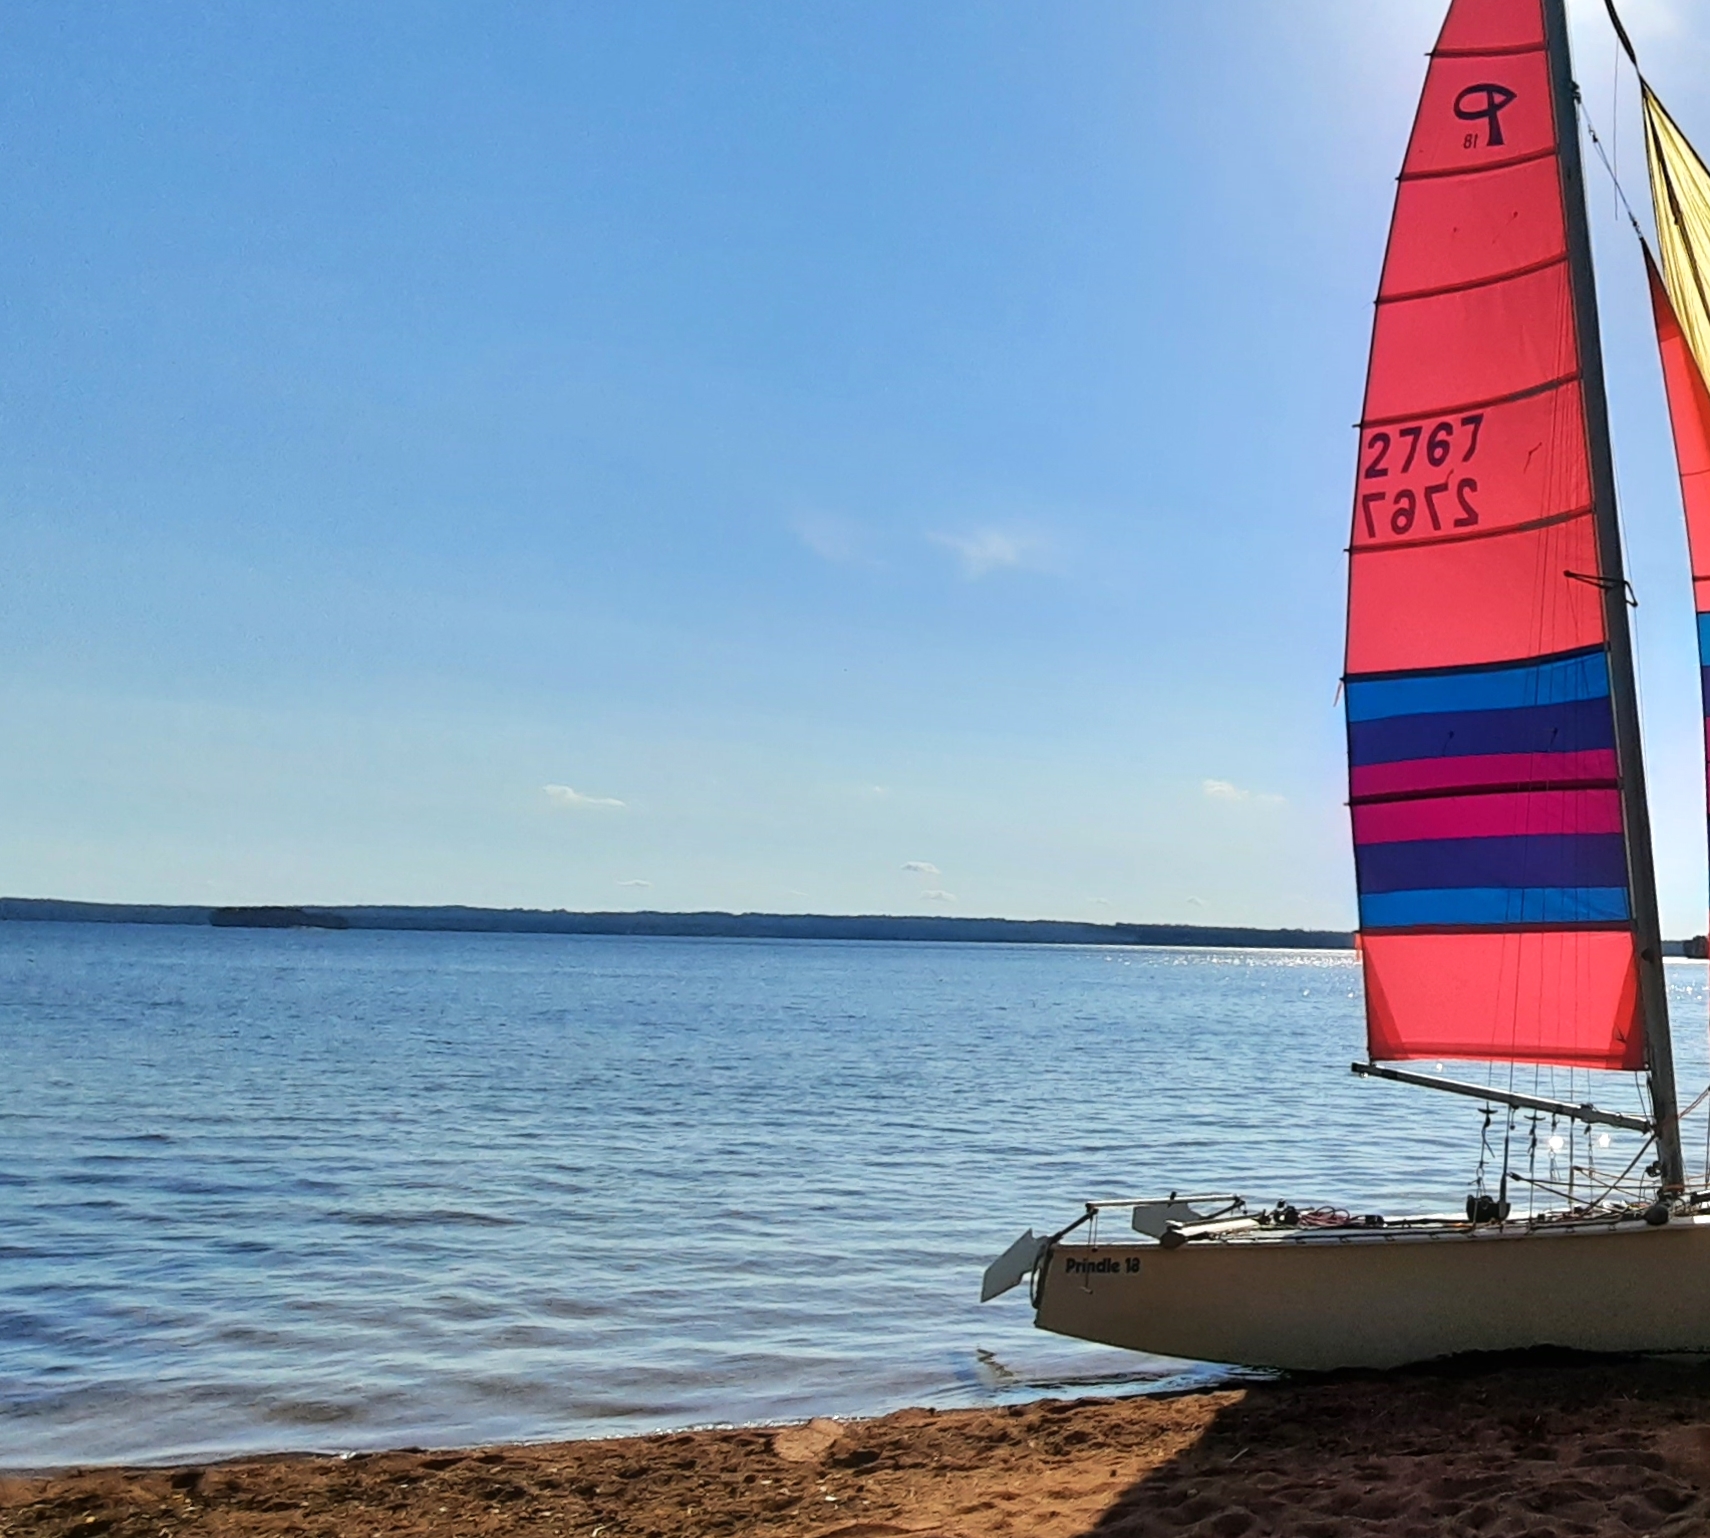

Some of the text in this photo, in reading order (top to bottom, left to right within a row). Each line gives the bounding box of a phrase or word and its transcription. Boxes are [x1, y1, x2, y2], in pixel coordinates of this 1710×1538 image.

[1364, 413, 1484, 479] 2767
[1065, 1257, 1140, 1273] Prindle 18
